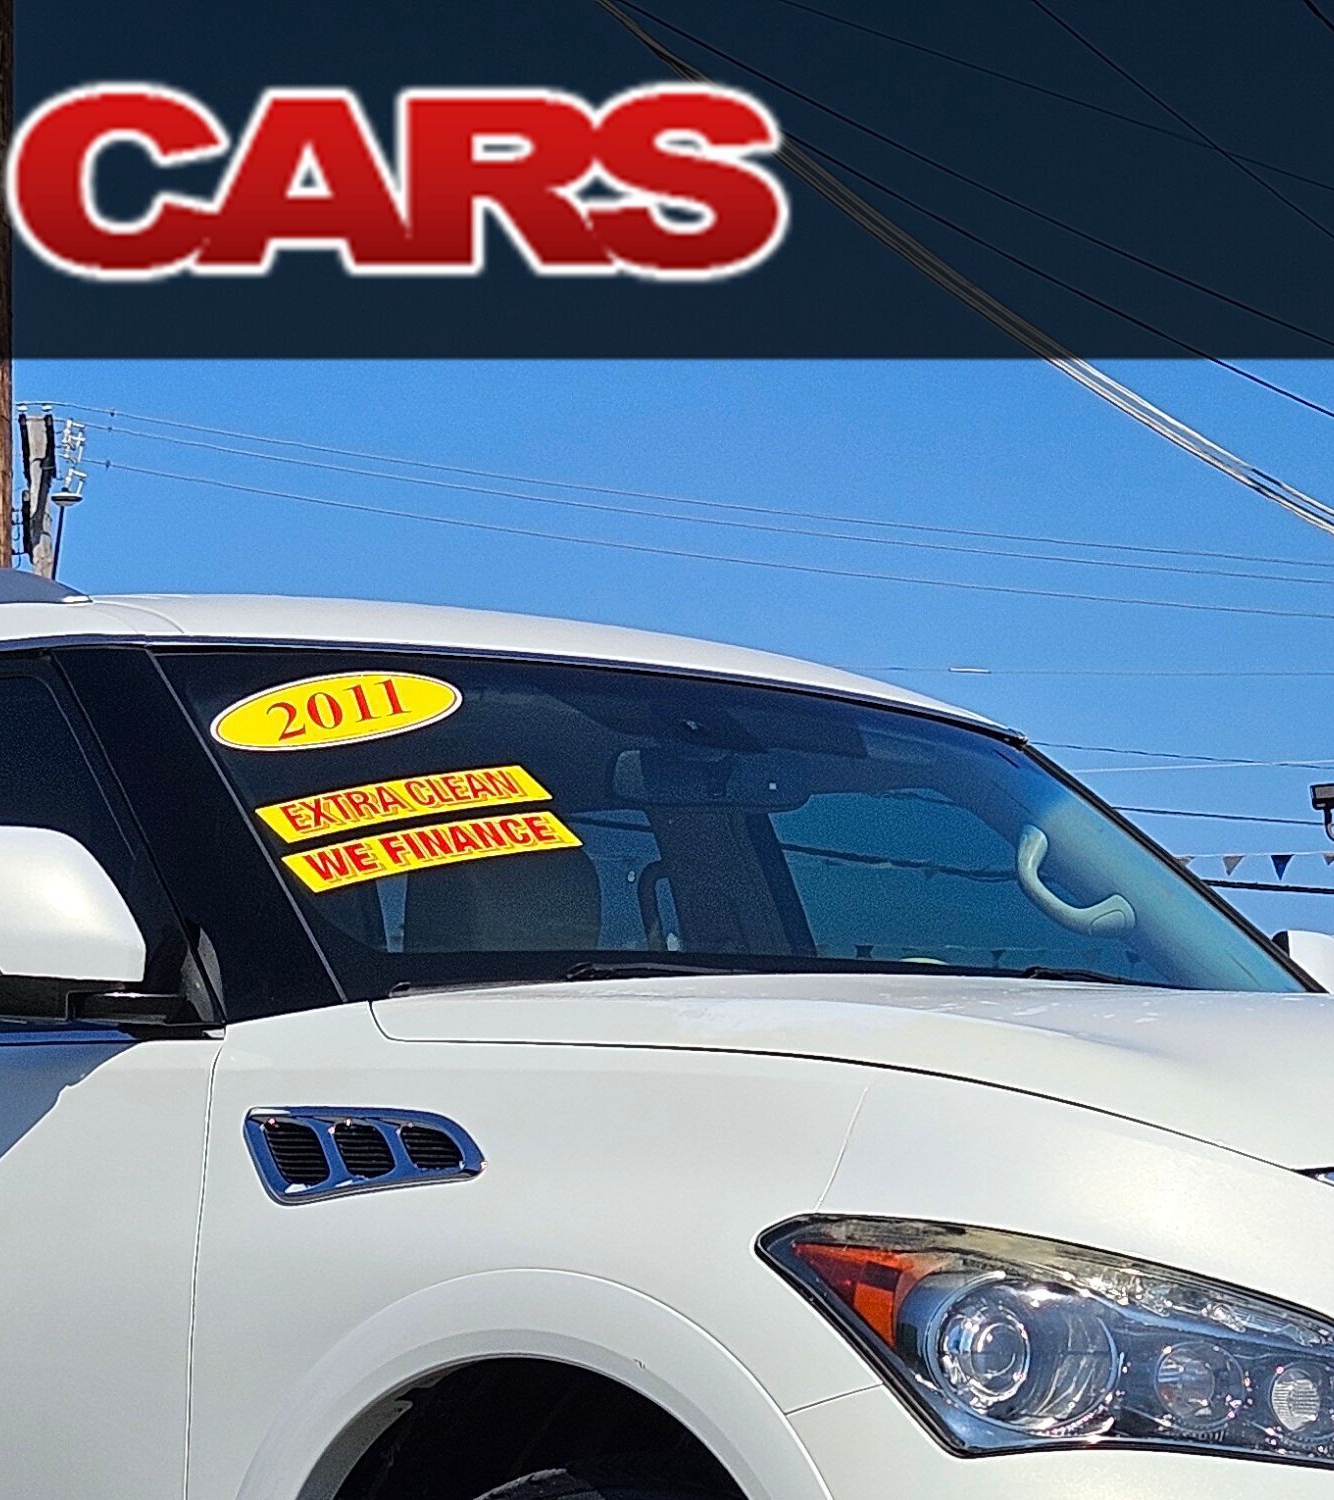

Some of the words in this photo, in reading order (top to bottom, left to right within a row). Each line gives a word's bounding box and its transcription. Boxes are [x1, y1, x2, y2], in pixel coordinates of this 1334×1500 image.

[267, 679, 412, 742] 2011
[283, 781, 409, 834] EXTRA
[405, 769, 523, 808] CLEAN
[304, 843, 382, 882] WE
[379, 815, 562, 868] FINANCE
